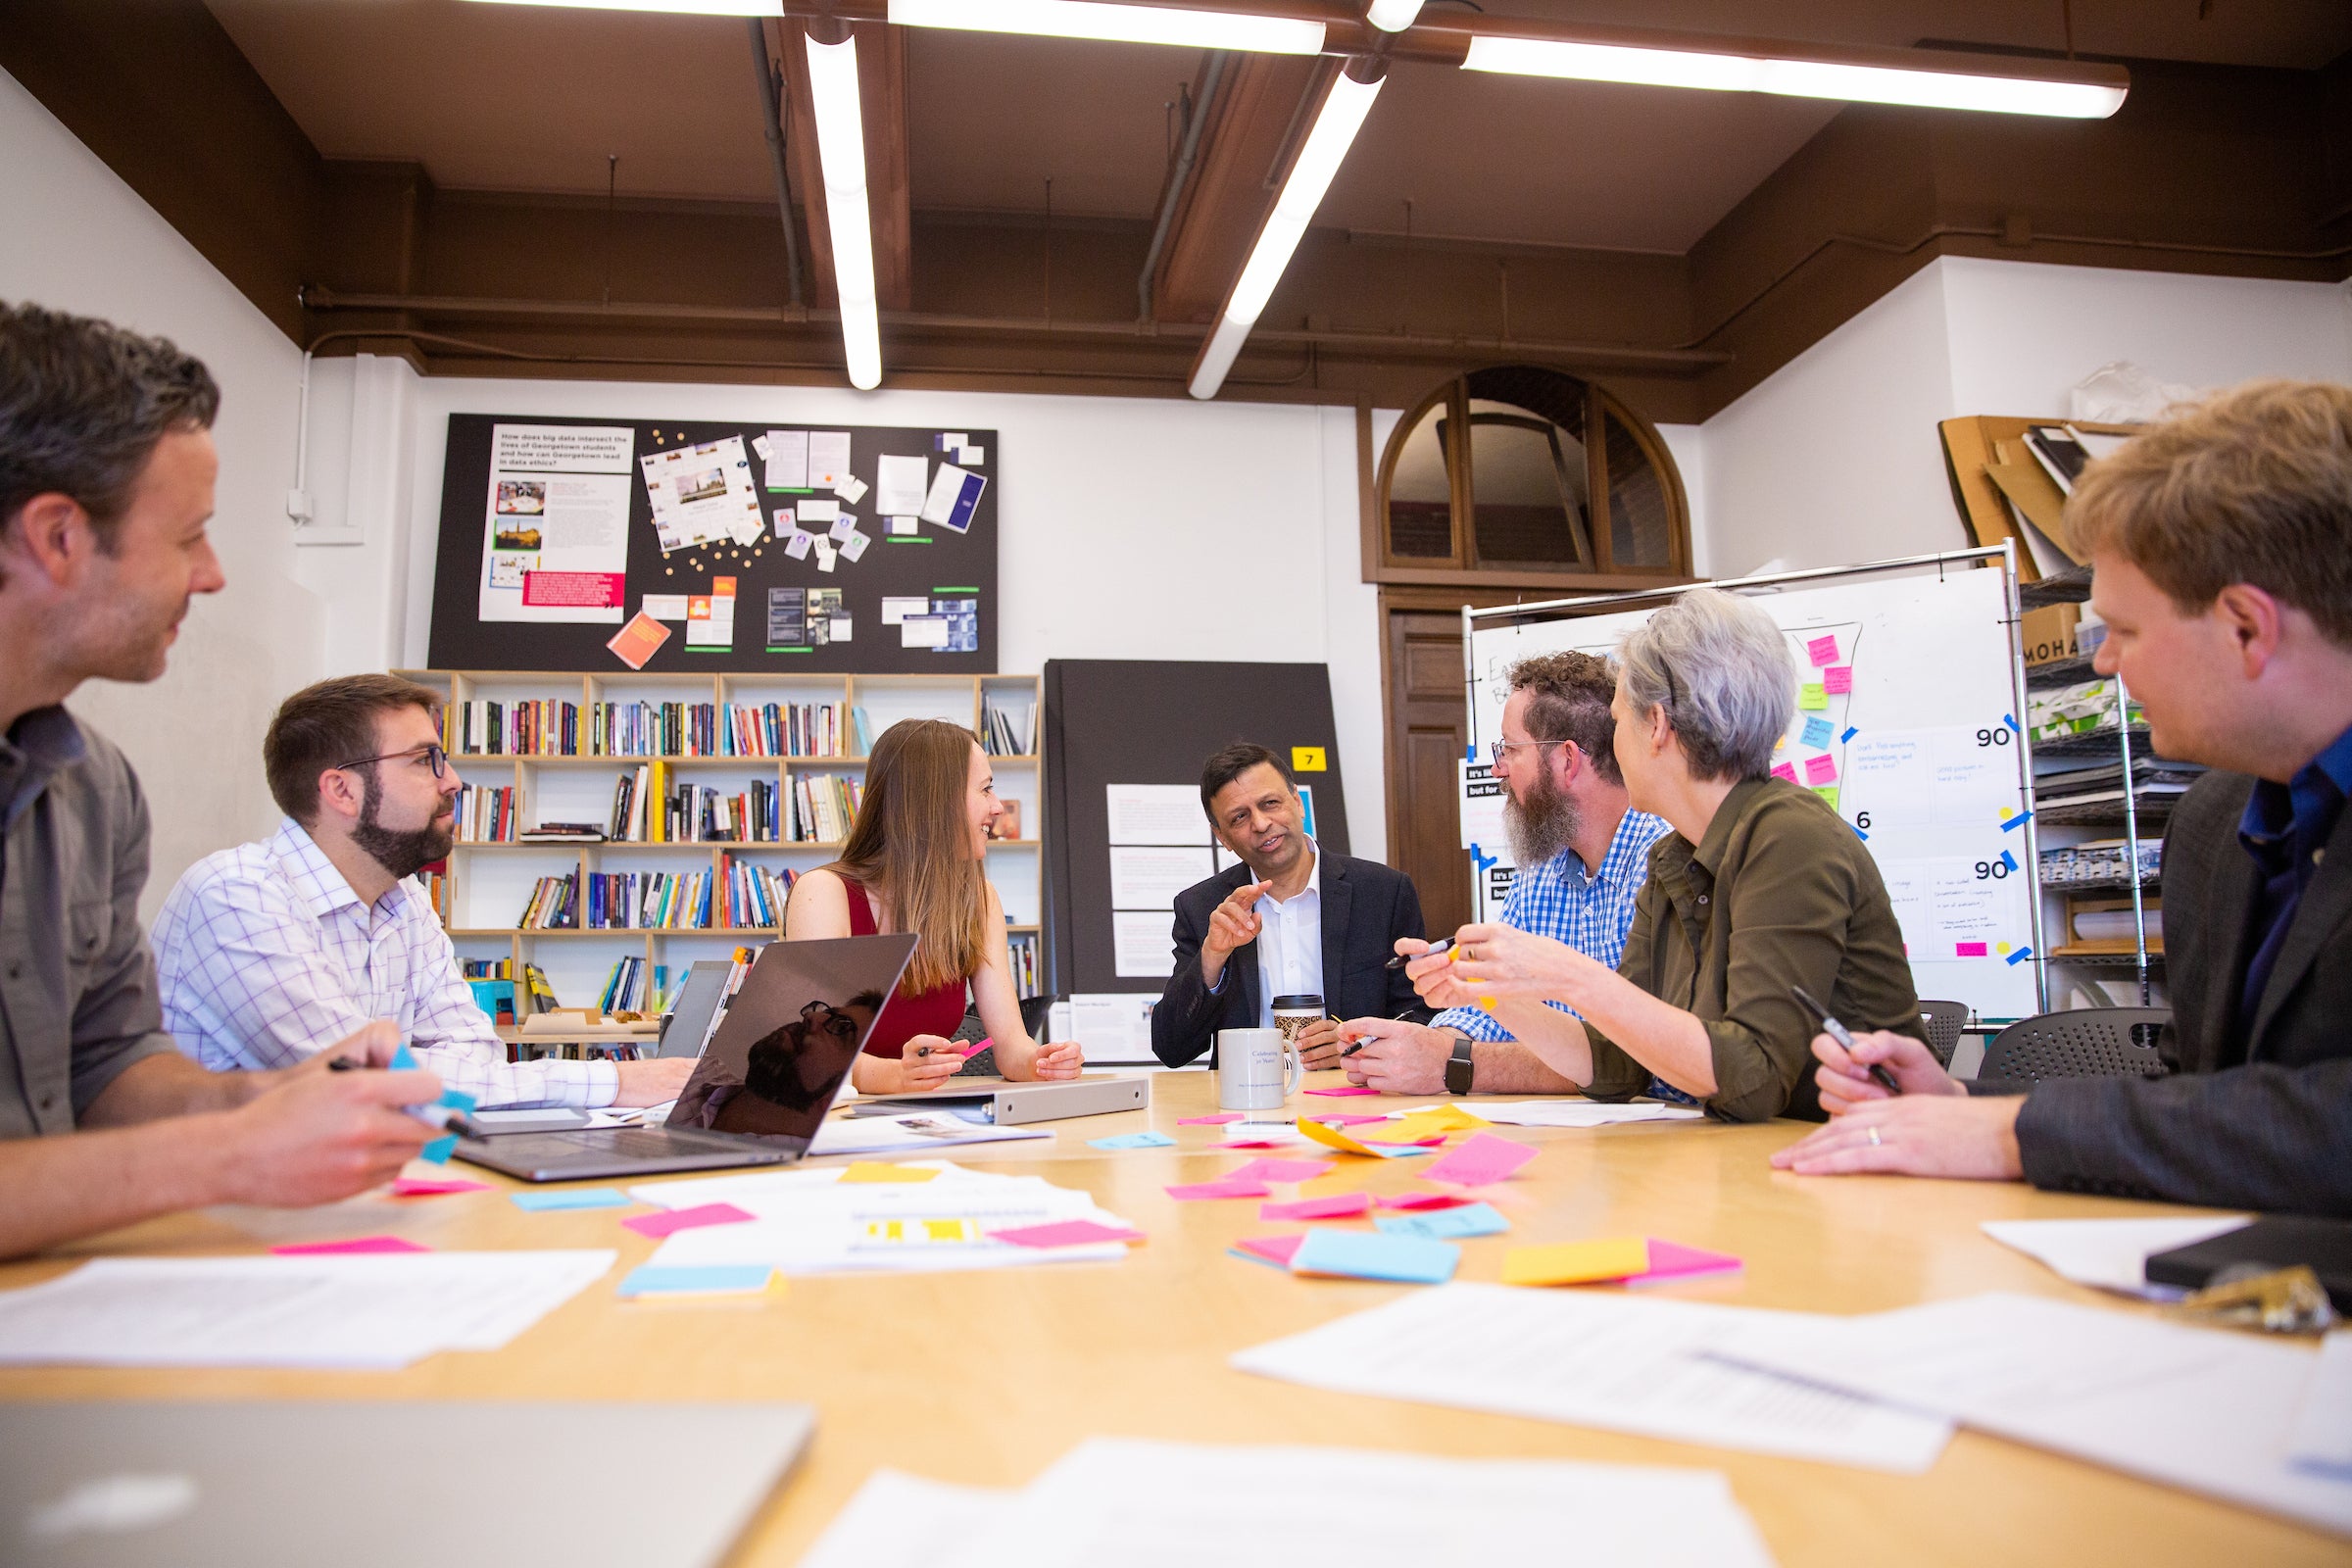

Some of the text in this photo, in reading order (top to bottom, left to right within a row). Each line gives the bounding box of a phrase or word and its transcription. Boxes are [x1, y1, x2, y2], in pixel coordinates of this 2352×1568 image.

[532, 442, 580, 451] Georgetown
[553, 452, 601, 461] Georgetown
[1977, 728, 2010, 747] 90
[1305, 755, 1313, 764] 7
[1469, 769, 1483, 778] It's
[1469, 785, 1498, 795] but for
[1857, 811, 1871, 829] 6
[1975, 860, 2009, 880] 90
[1494, 871, 1507, 880] It's
